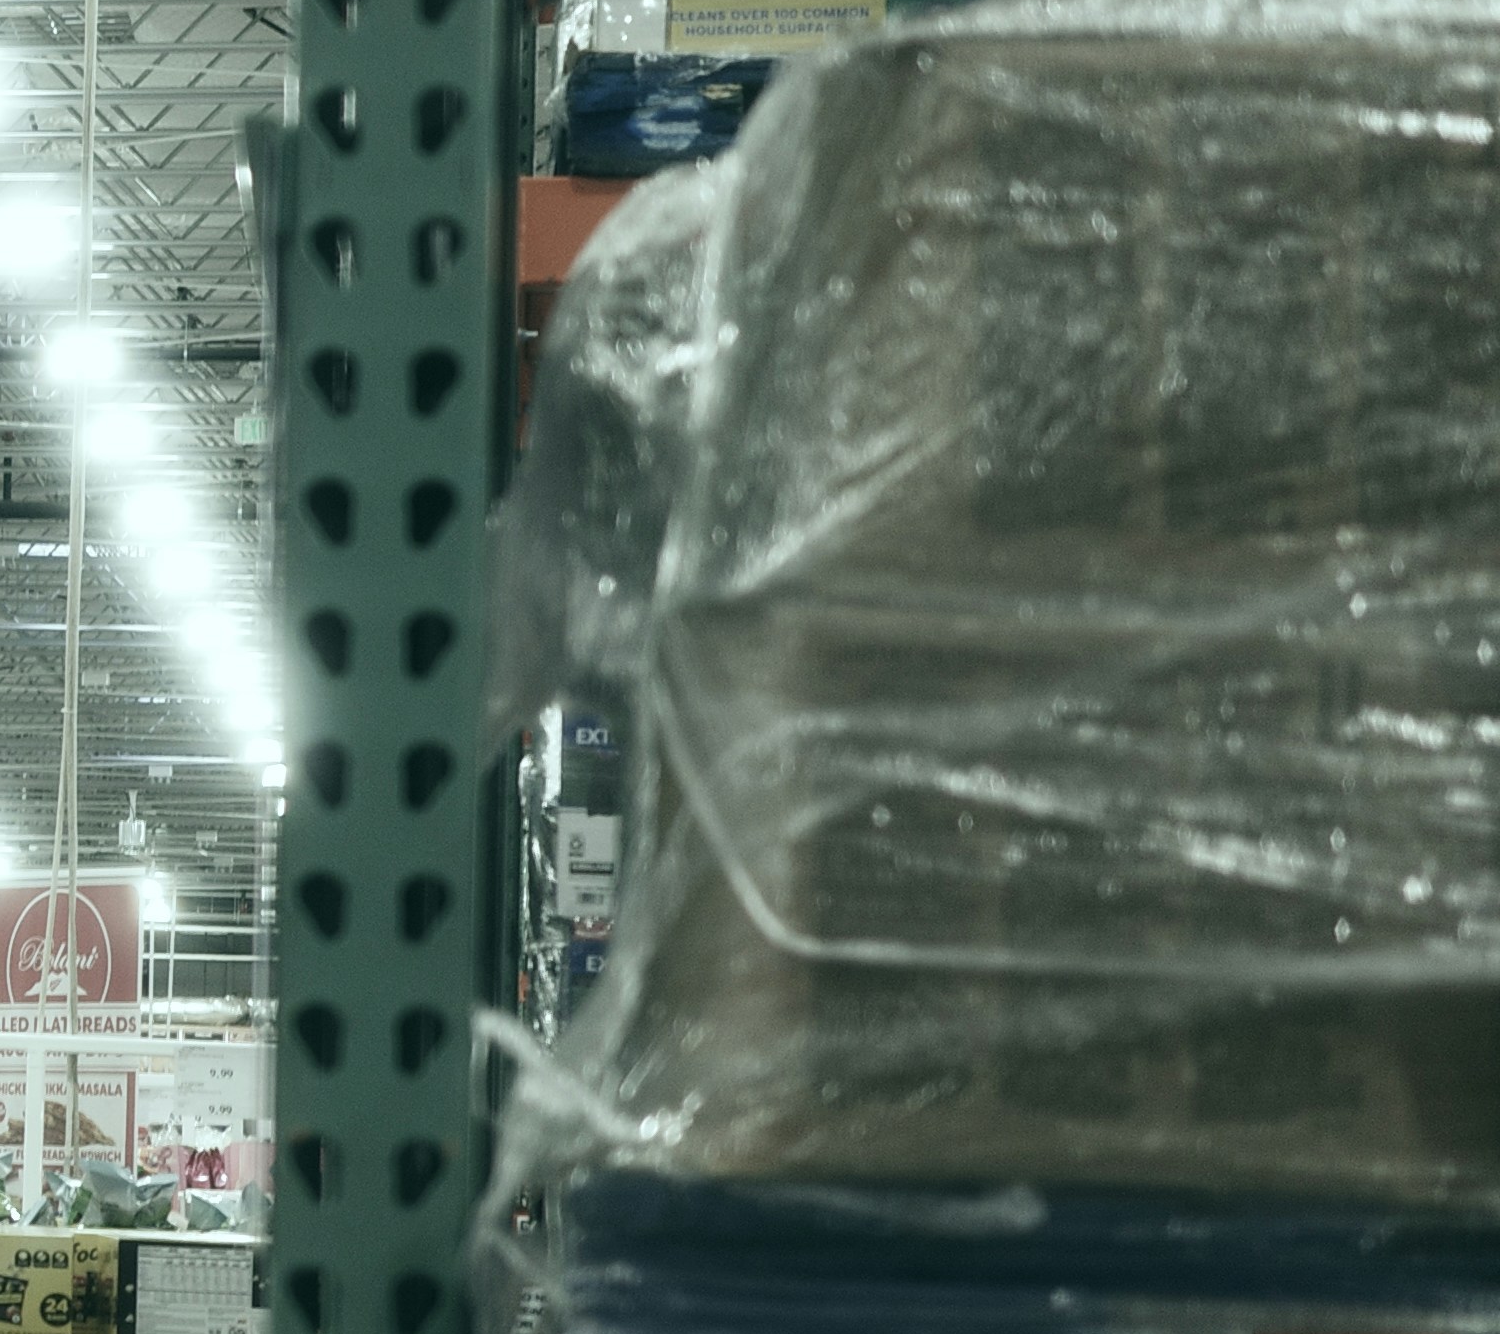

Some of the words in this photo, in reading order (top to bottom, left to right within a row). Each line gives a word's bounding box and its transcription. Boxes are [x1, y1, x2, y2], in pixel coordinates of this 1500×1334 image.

[731, 9, 769, 21] OVER
[774, 8, 799, 21] 100
[802, 7, 870, 20] COMMON
[685, 24, 773, 37] HOUSEHOLD
[46, 1297, 70, 1314] 24
